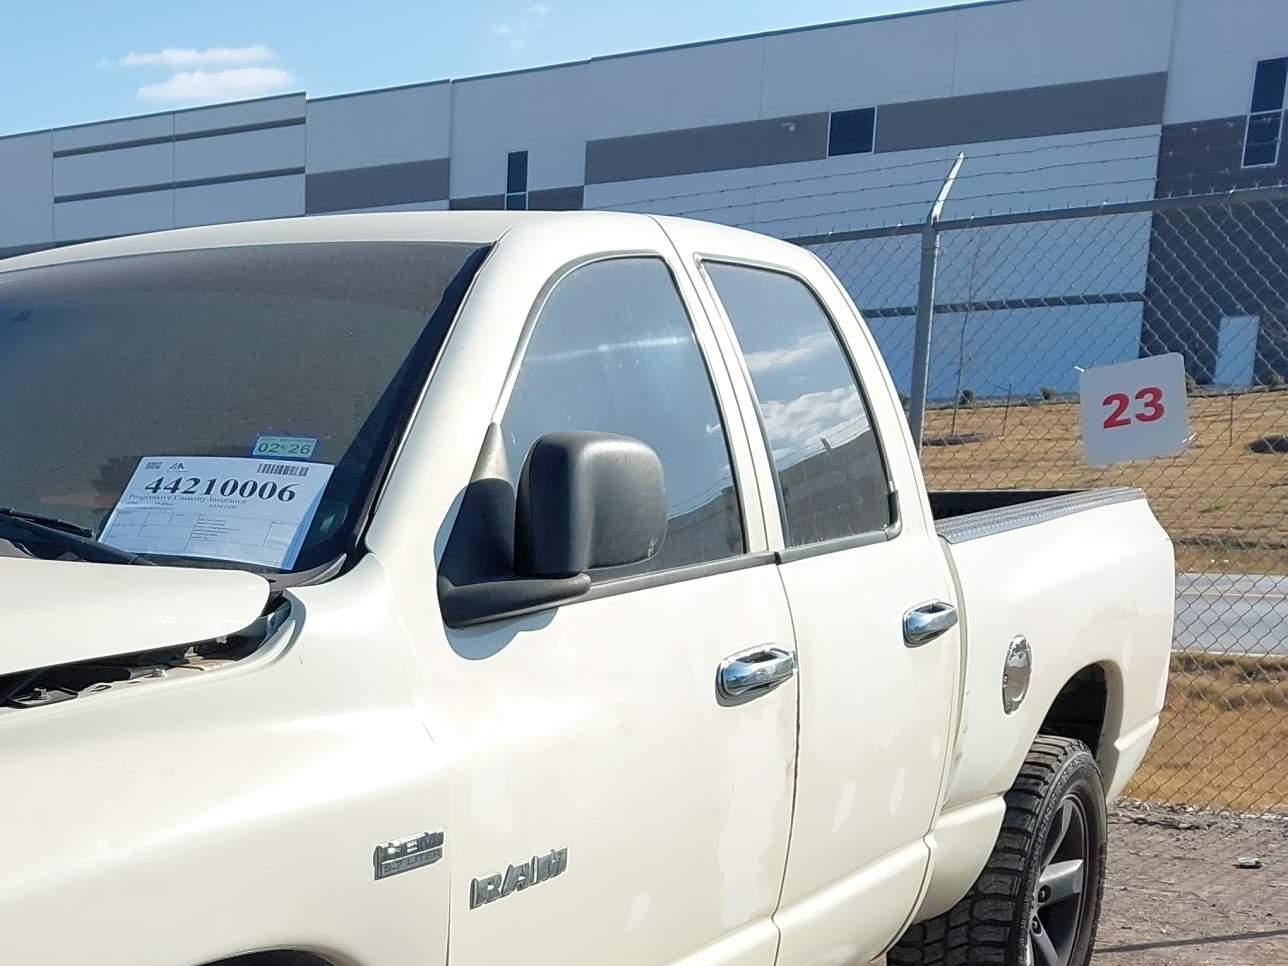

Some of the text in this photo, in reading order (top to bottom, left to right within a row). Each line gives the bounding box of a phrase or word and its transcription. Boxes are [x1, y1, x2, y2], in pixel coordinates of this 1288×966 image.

[1102, 386, 1165, 429] 23
[257, 441, 312, 455] 02 26
[144, 476, 303, 503] 44210006
[209, 495, 247, 505] Insurance
[407, 849, 442, 869] LITER
[470, 847, 569, 910] RAM
